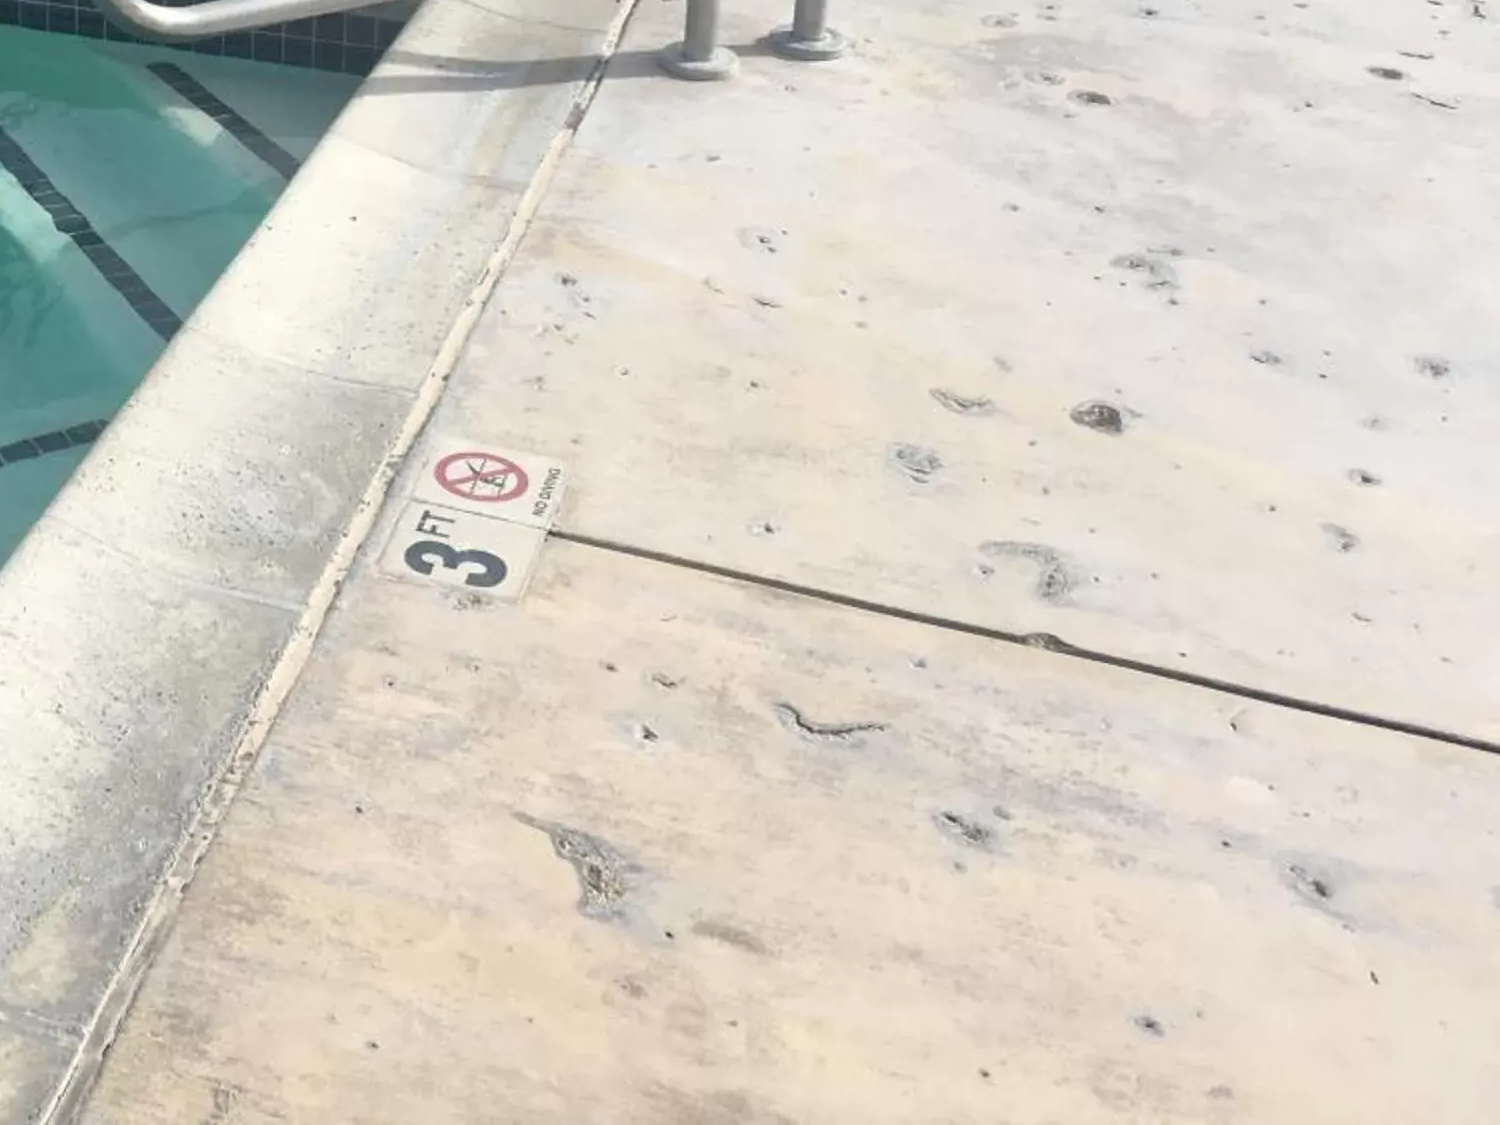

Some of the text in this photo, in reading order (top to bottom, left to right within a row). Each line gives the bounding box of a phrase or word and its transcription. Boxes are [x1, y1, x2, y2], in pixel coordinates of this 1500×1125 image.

[531, 467, 562, 517] NO DIVING
[404, 509, 508, 588] 3 FT
